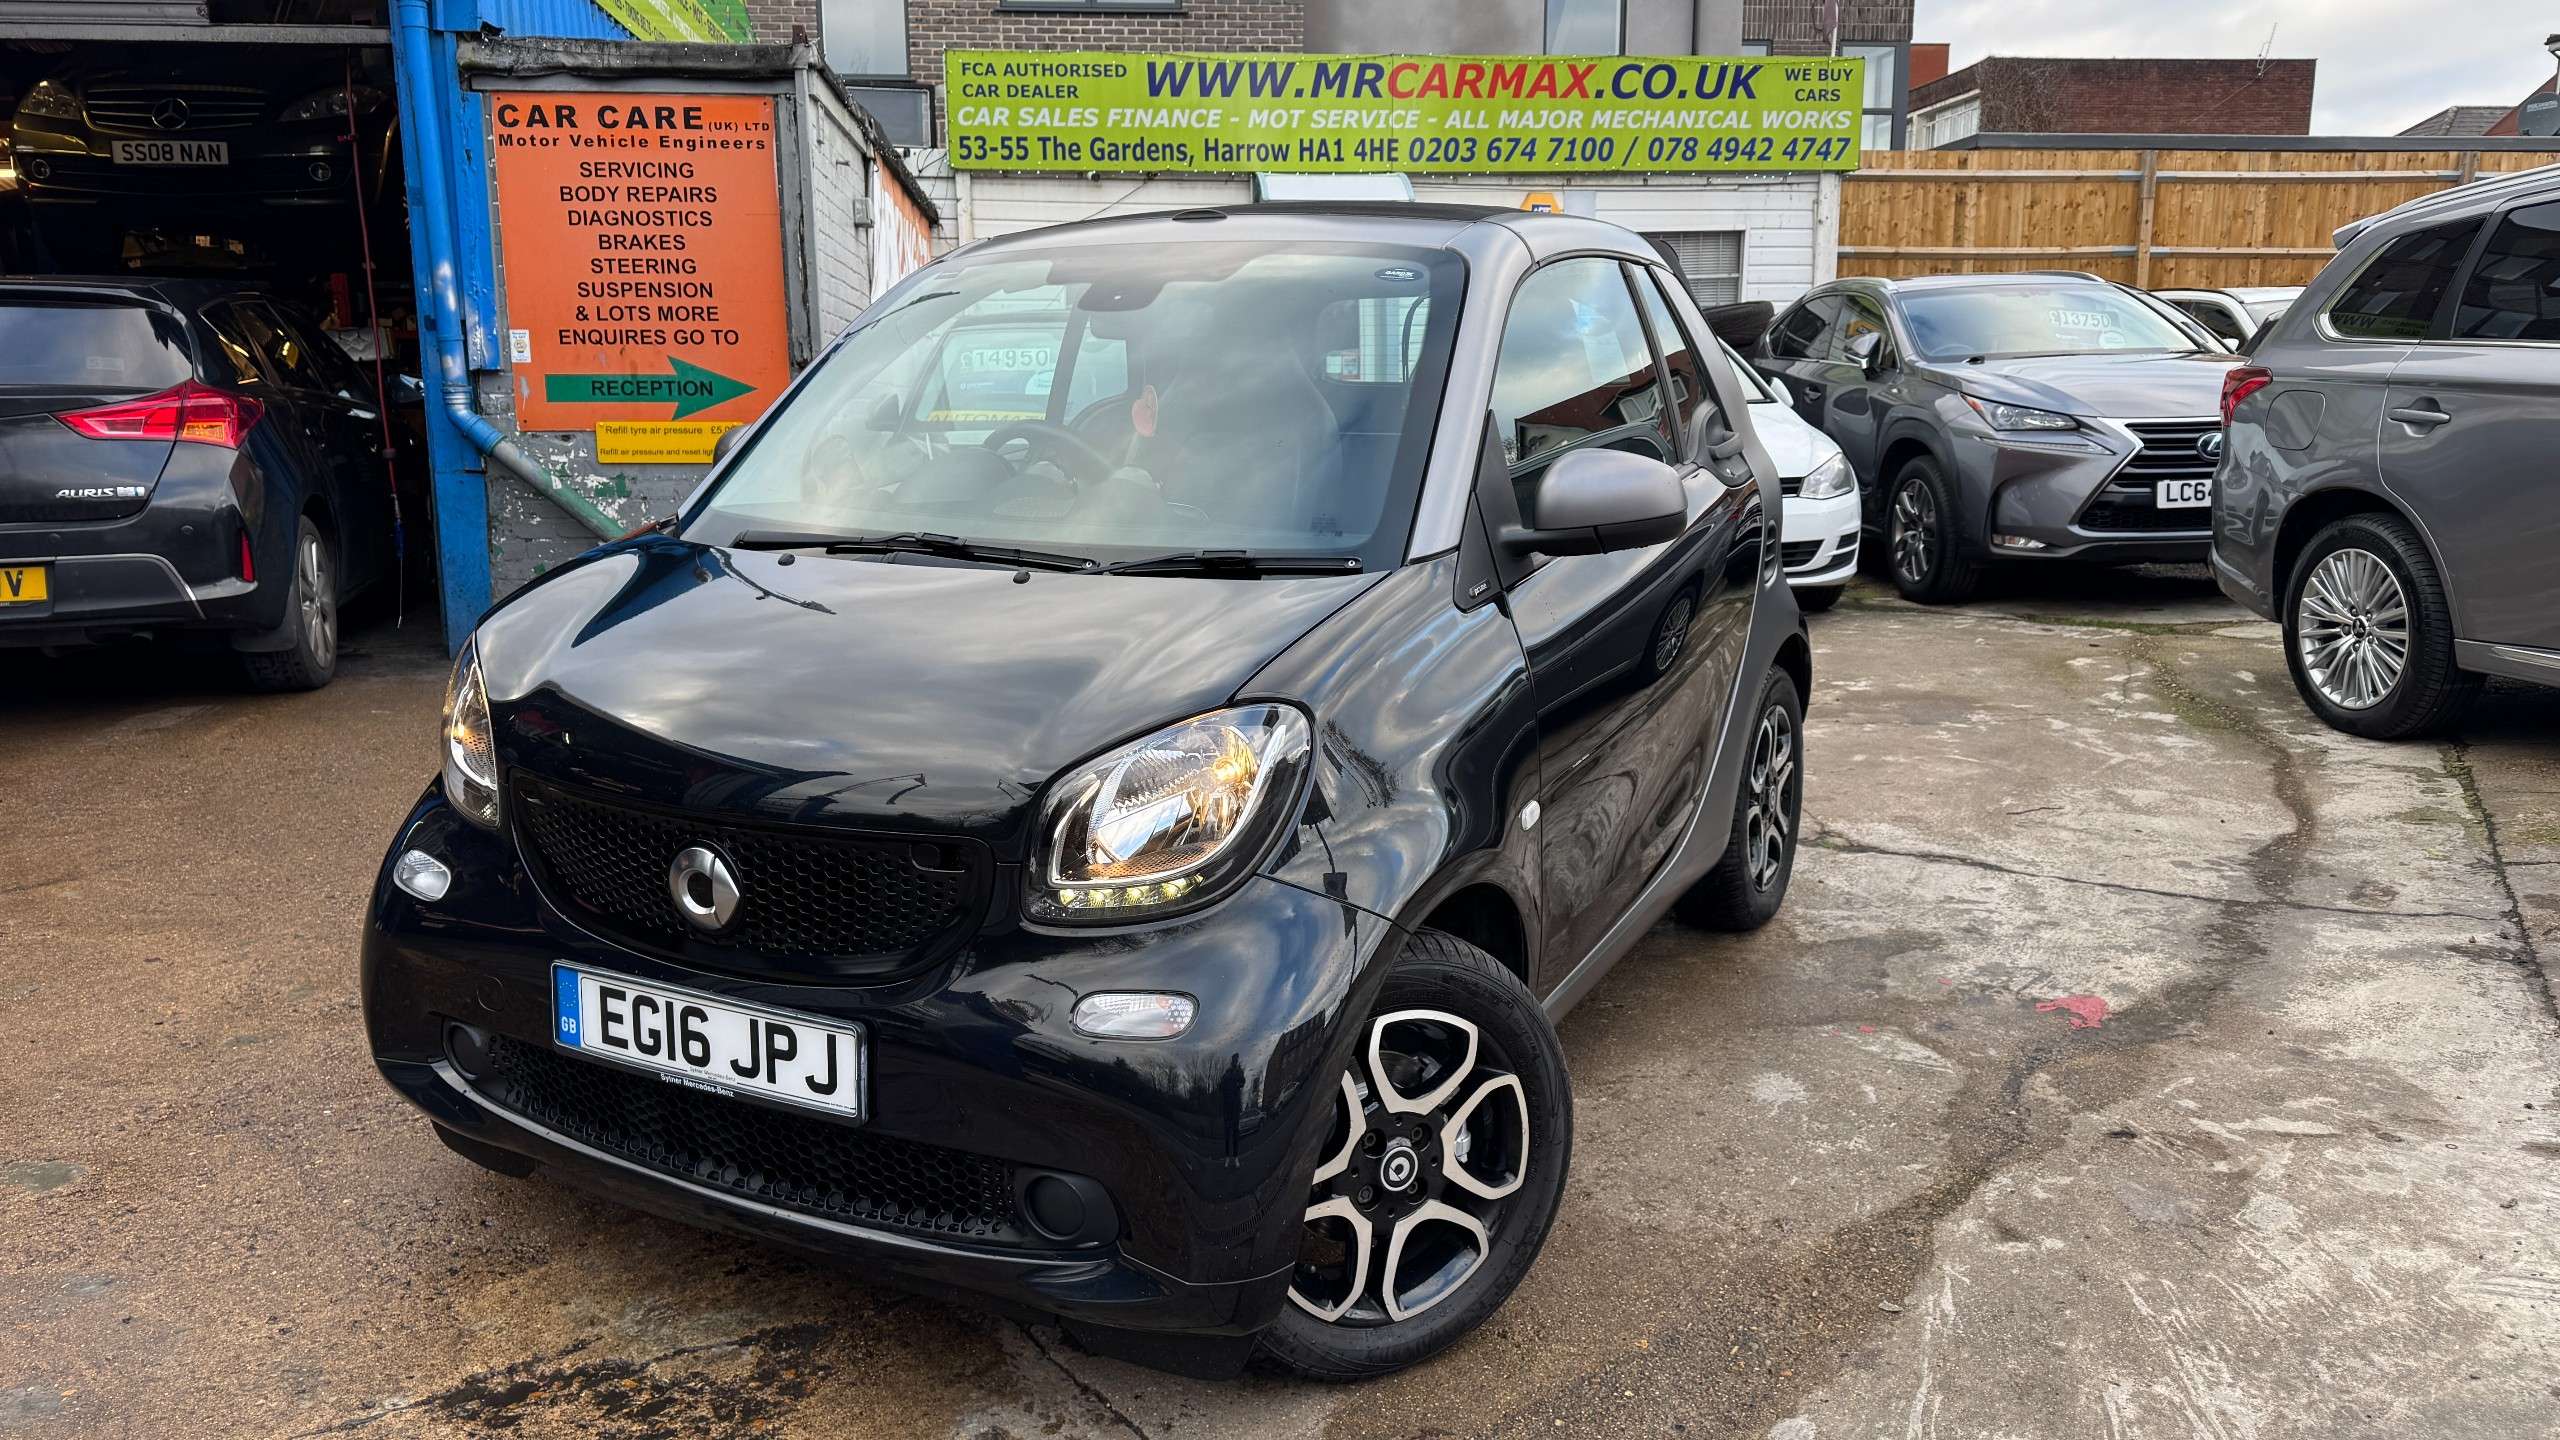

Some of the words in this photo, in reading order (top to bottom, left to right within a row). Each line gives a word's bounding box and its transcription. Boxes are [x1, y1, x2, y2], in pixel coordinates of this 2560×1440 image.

[961, 62, 996, 77] FCA
[1003, 63, 1127, 78] AUTHORISED
[1785, 68, 1814, 82] WE
[1818, 68, 1853, 82] BUY
[1146, 61, 1764, 99] WWW.MRCARMAX.CO.UK
[962, 83, 1000, 98] CAR
[1006, 84, 1079, 99] DEALER
[1794, 88, 1841, 102] CARS
[497, 104, 578, 129] CAR
[597, 105, 704, 130] CARE
[708, 121, 739, 133] (UK)
[745, 121, 770, 132] LTD
[957, 106, 1014, 127] CAR
[1018, 107, 1099, 128] SALES
[1106, 108, 1222, 129] FINANCE
[1248, 108, 1304, 129] MOT
[1310, 109, 1419, 129] SERVICE
[1446, 110, 1491, 129] ALL
[1499, 110, 1583, 129] MAJOR
[1593, 110, 1753, 129] MECHANICAL
[1762, 110, 1852, 129] WORKS
[498, 134, 559, 147] Motor
[569, 134, 649, 148] Vehicle
[659, 136, 766, 152] Engineers
[959, 135, 1029, 161] 53-55
[1037, 136, 1081, 162] The
[1089, 136, 1194, 168] Gardens,
[1204, 137, 1290, 162] Harrow
[1299, 138, 1345, 162] HA1
[1354, 138, 1399, 162] 4HE
[1408, 137, 1476, 162] 0203
[1486, 137, 1536, 162] 674
[1547, 136, 1614, 162] 7100
[1647, 137, 1697, 162] 078
[1707, 136, 1774, 162] 4942
[1782, 136, 1851, 162] 4747
[122, 143, 174, 161] SS08
[180, 143, 221, 162] NAN
[579, 162, 694, 178] SERVICING
[560, 186, 619, 202] BODY
[627, 187, 717, 203] REPAIRS
[568, 210, 713, 227] DIAGNOSTICS
[598, 234, 686, 250] BRAKES
[590, 258, 697, 274] STEERING
[577, 281, 713, 298] SUSPENSION
[575, 305, 589, 321] &
[596, 306, 651, 322] LOTS
[658, 306, 719, 322] MORE
[559, 329, 667, 345] ENQUIRES
[673, 329, 705, 345] GO
[711, 329, 739, 345] TO
[591, 380, 713, 396] RECEPTION
[630, 426, 647, 436] tyre
[650, 426, 661, 434] air
[664, 426, 703, 436] pressure
[56, 487, 114, 498] AURIS
[560, 1015, 577, 1034] GB
[599, 984, 711, 1068] EG16
